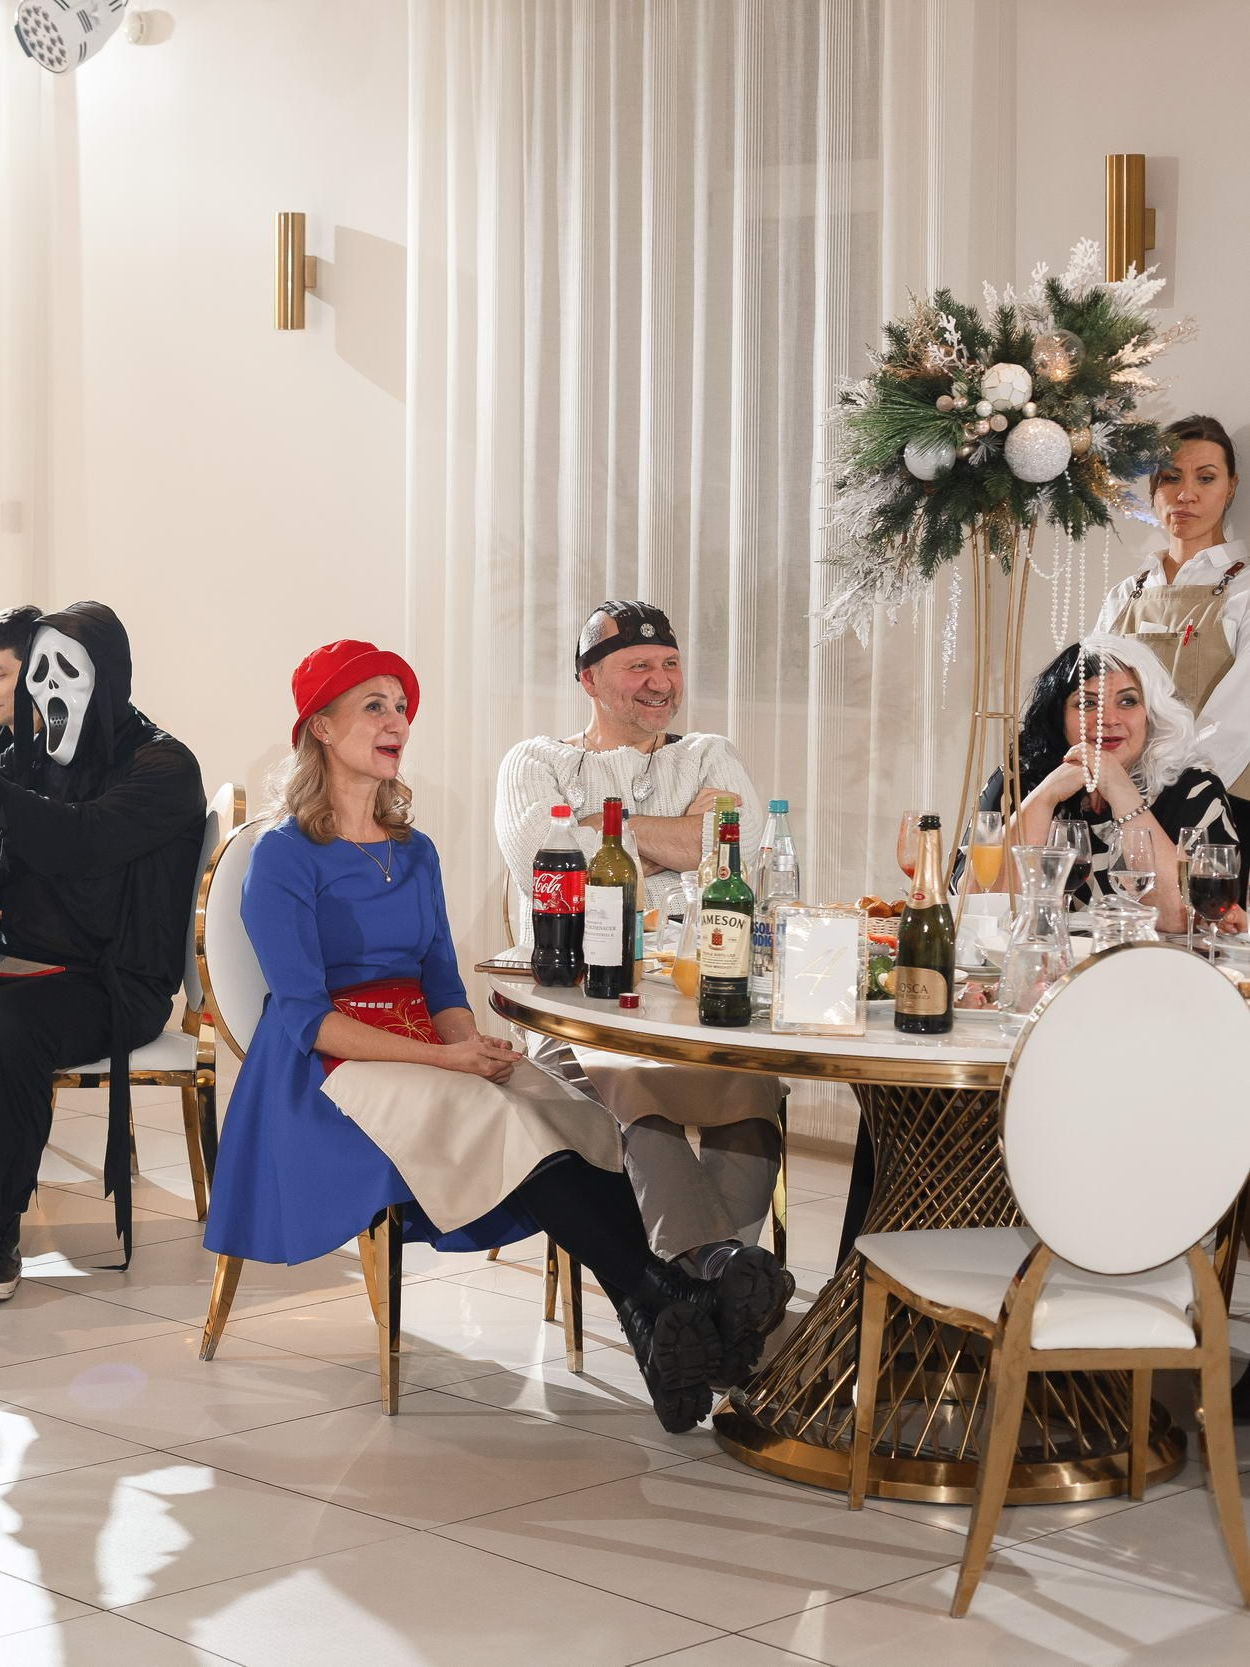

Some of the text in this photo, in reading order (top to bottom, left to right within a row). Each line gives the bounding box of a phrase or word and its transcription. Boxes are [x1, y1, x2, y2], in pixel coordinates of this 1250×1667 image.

[702, 915, 745, 930] AMESON
[795, 945, 849, 996] 4
[900, 982, 928, 994] OSCA
